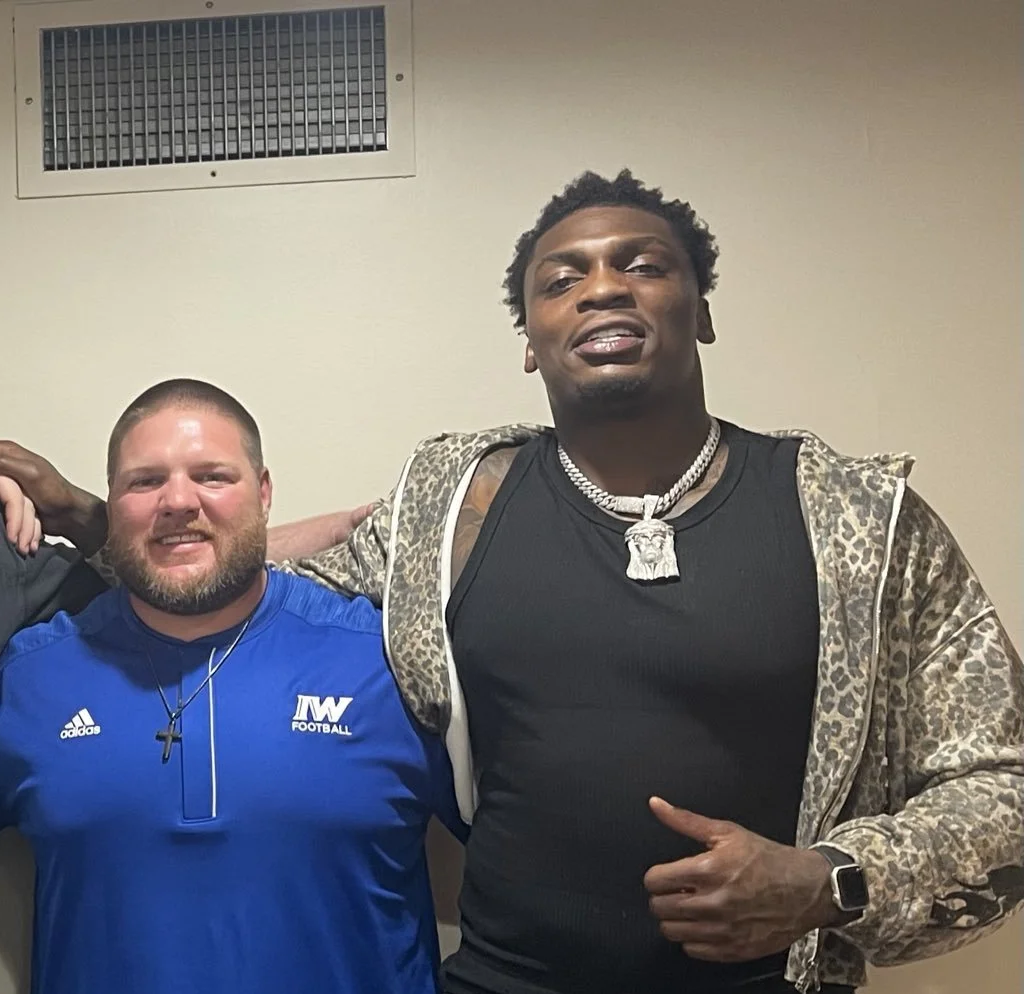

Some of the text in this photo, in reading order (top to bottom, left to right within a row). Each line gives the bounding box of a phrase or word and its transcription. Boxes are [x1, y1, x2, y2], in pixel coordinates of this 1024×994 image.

[292, 694, 354, 723] IW
[60, 724, 102, 740] adidas
[291, 721, 353, 736] FOOTBALL
